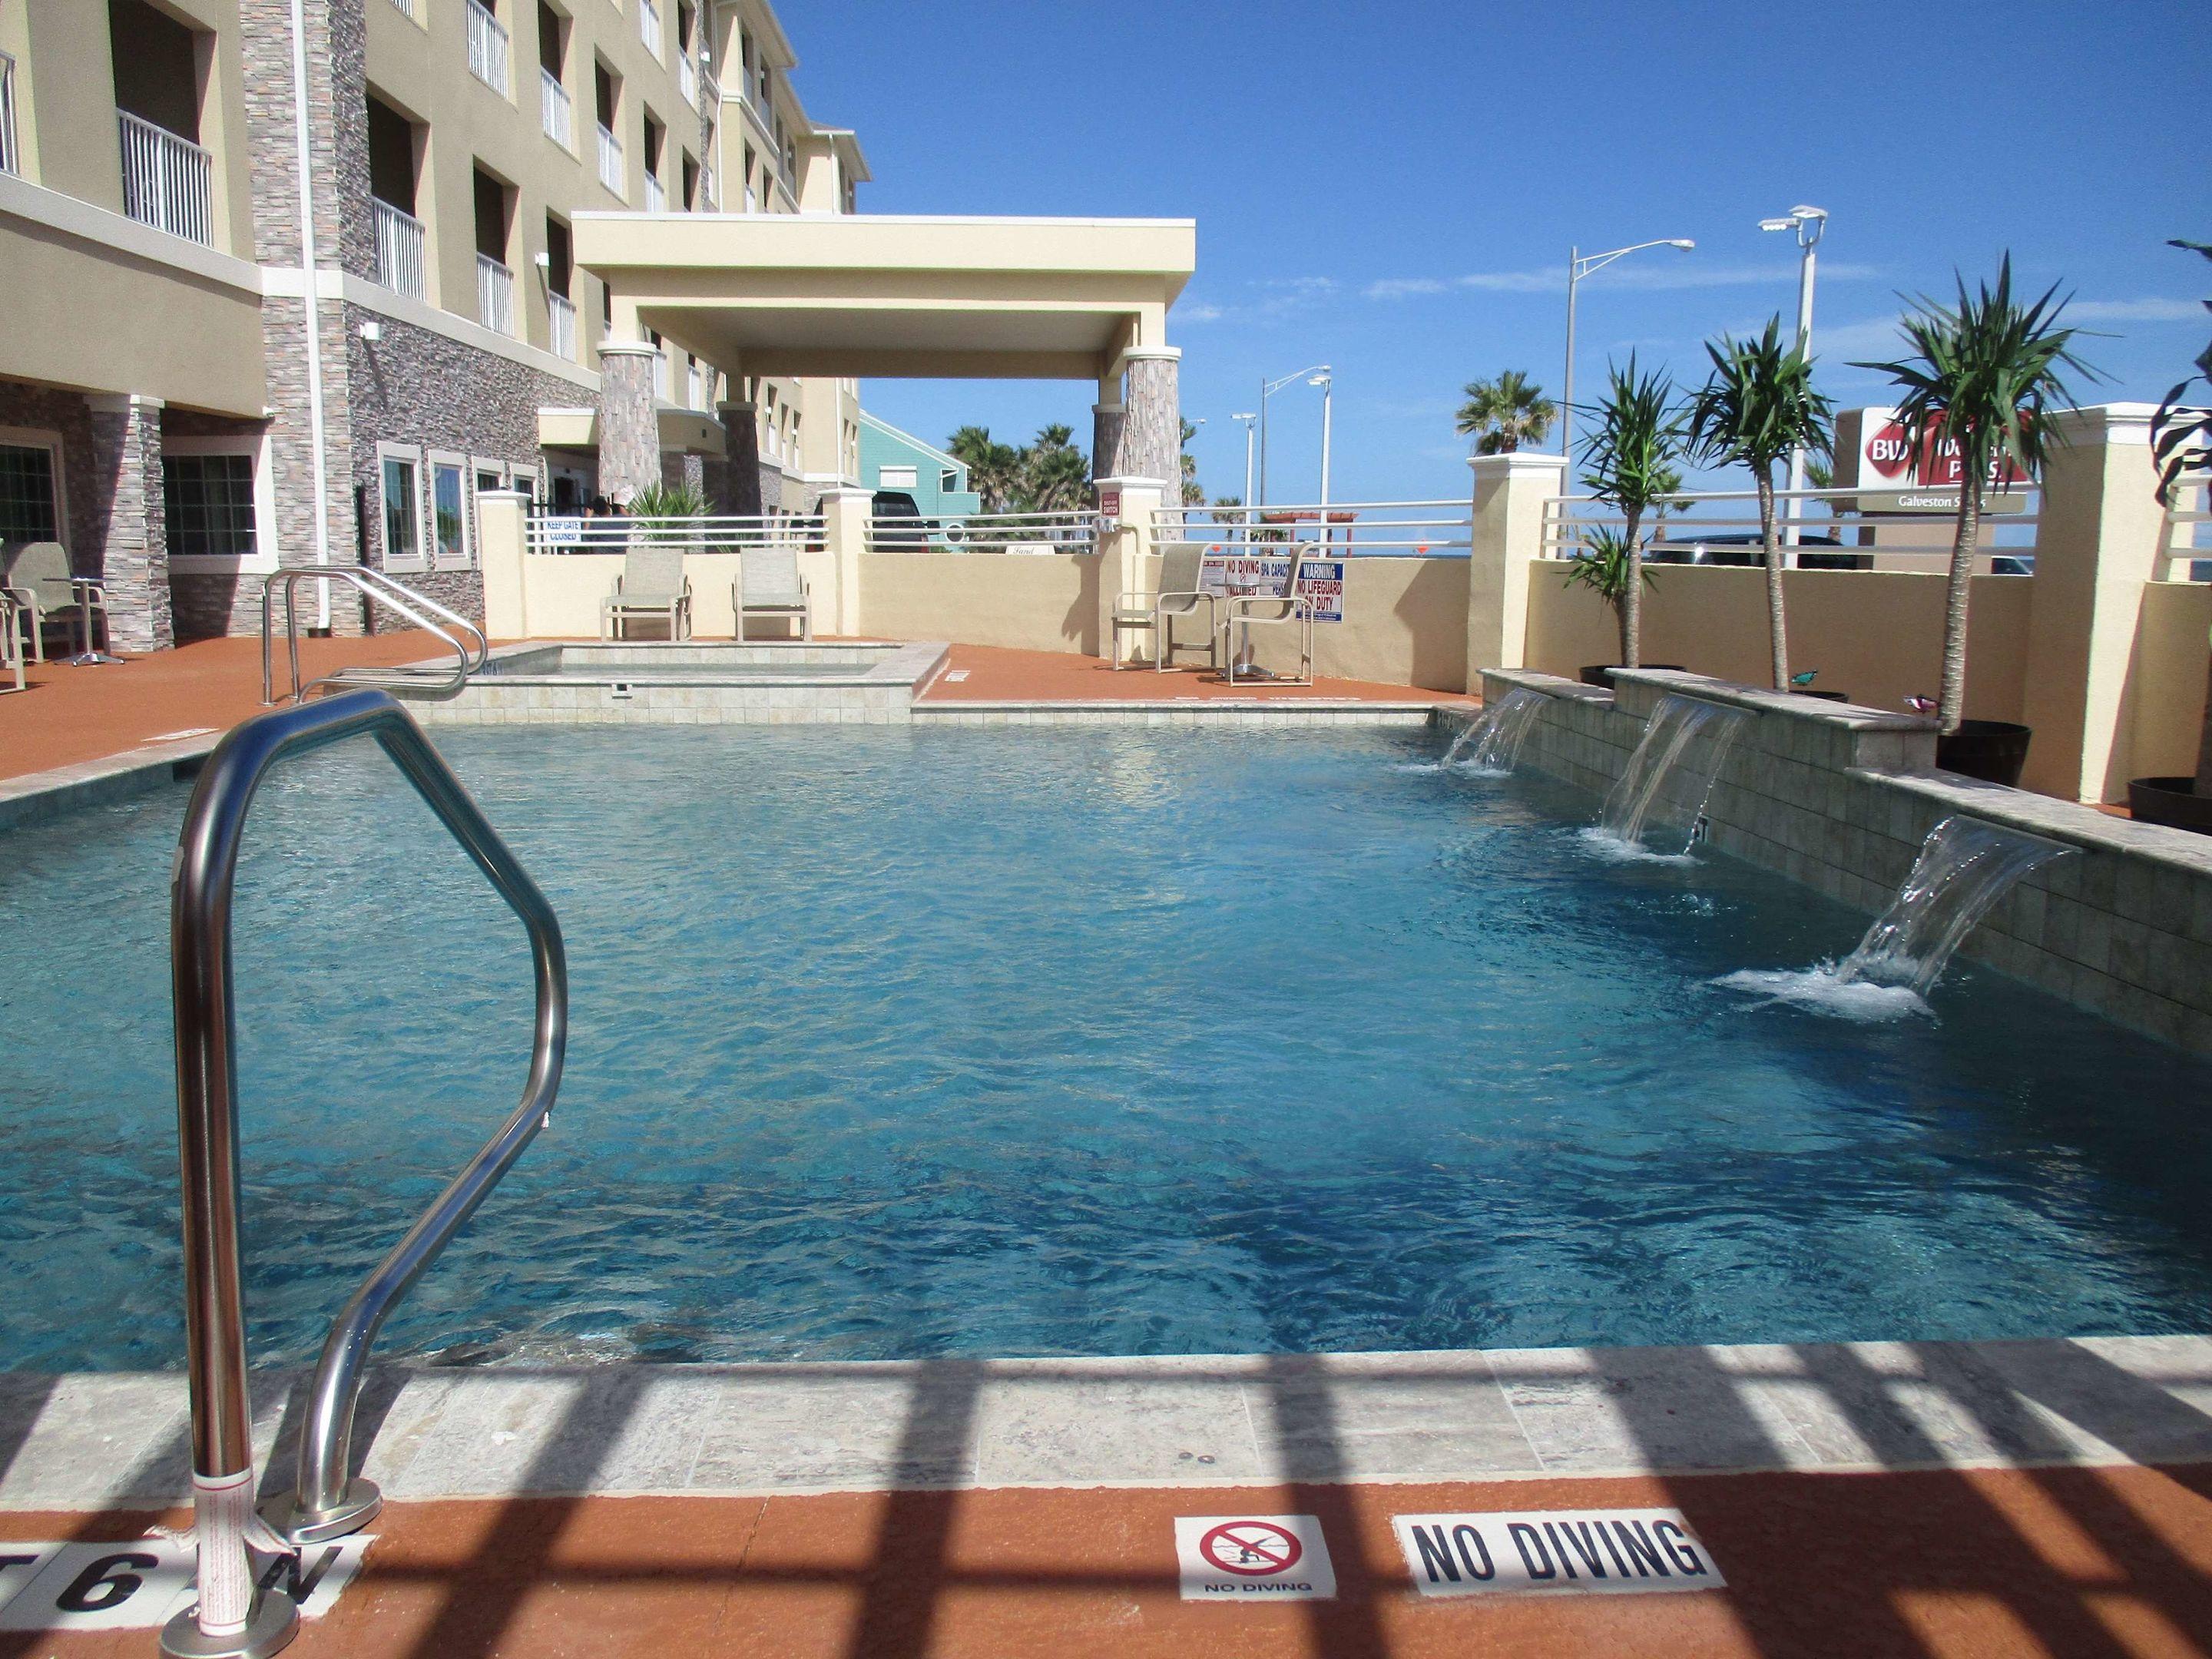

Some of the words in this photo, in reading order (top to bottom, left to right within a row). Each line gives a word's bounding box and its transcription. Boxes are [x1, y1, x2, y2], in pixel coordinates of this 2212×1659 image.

[1899, 495, 1952, 508] Galveston
[547, 520, 562, 529] KEEP
[564, 520, 578, 529] GATE
[1227, 560, 1236, 574] NO
[1238, 560, 1260, 575] DIVING
[1261, 562, 1270, 577] SPA
[1271, 563, 1291, 578] CAPACIT
[1303, 564, 1336, 579] WARNING
[1297, 579, 1306, 594] NO
[1308, 580, 1342, 596] LIFEGUARD
[1316, 597, 1333, 611] DUTY
[1412, 1523, 1495, 1583] NO
[1507, 1519, 1707, 1580] DIVING
[56, 1553, 159, 1612] 6
[1204, 1583, 1236, 1592] NO
[1242, 1582, 1313, 1592] DIVING
